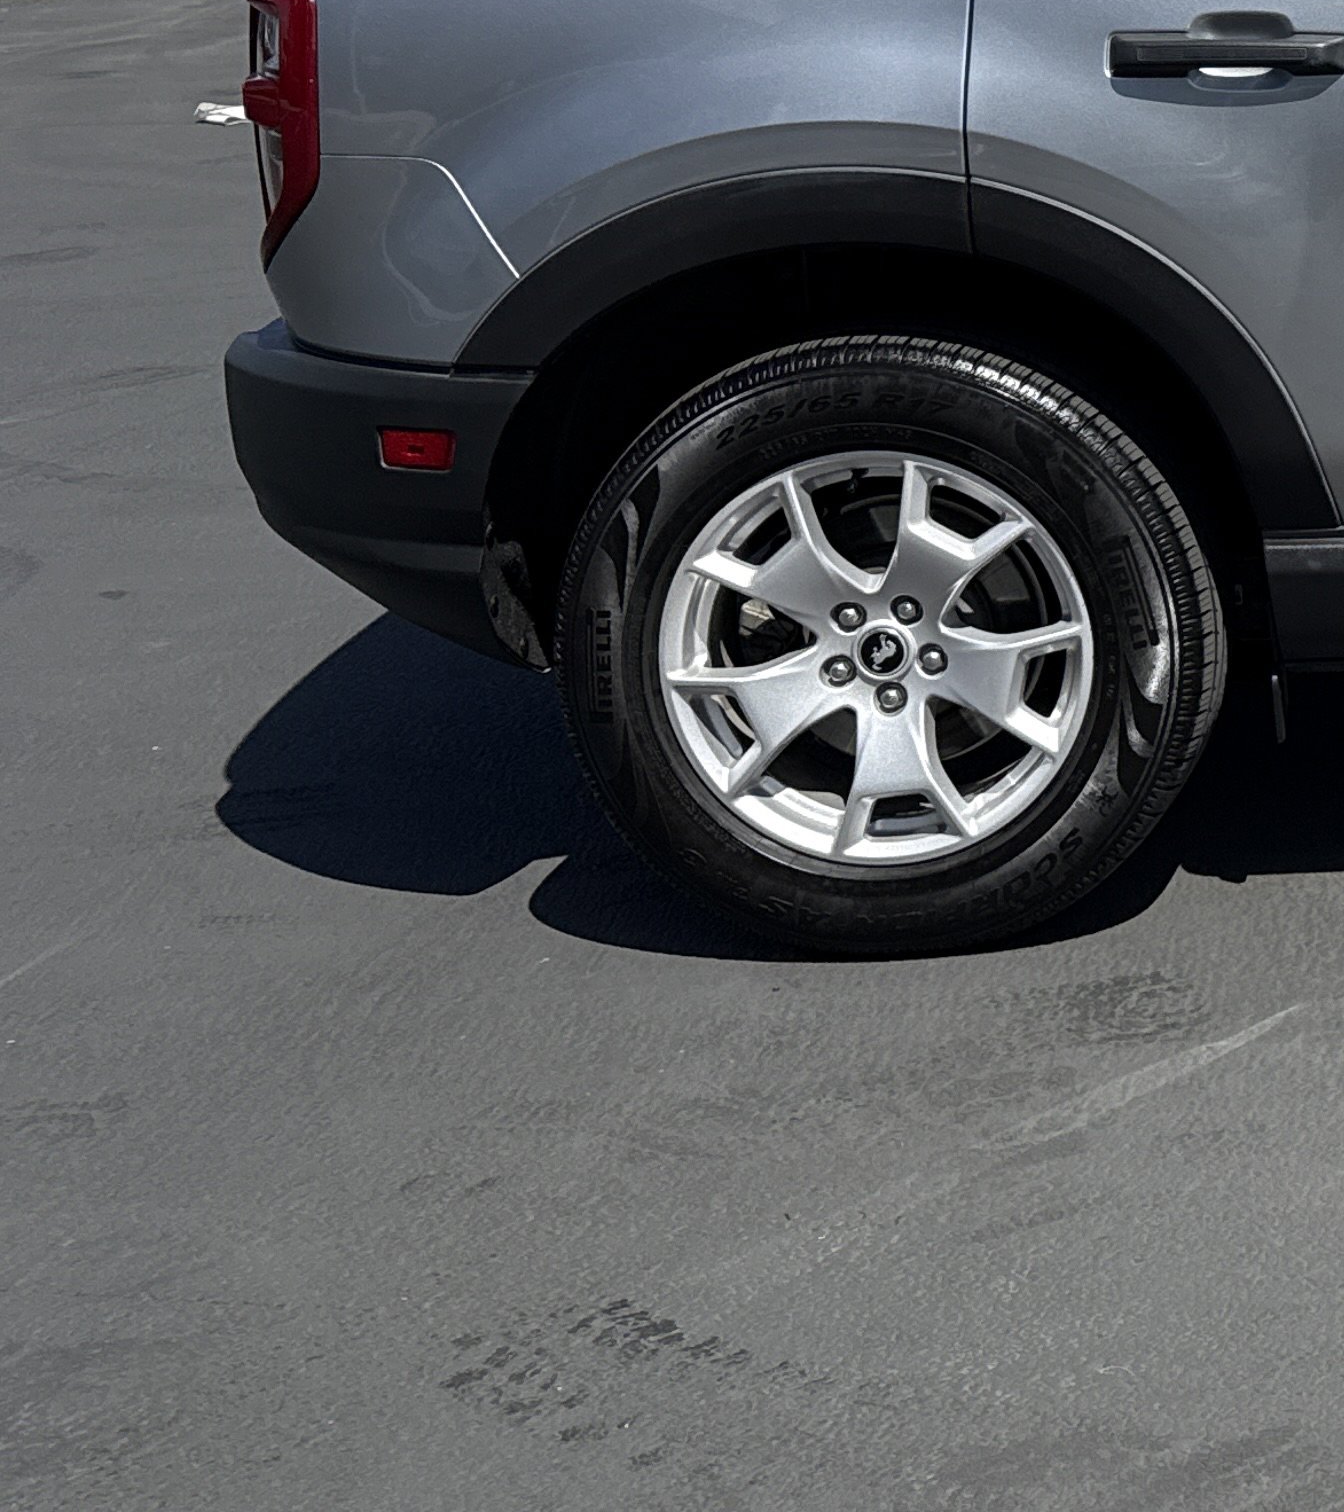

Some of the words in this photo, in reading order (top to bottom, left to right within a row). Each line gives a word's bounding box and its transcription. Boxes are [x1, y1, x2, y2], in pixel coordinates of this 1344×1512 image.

[716, 392, 862, 451] 225/65
[1102, 535, 1160, 650] PIRELLI
[585, 606, 615, 724] PIRELLI
